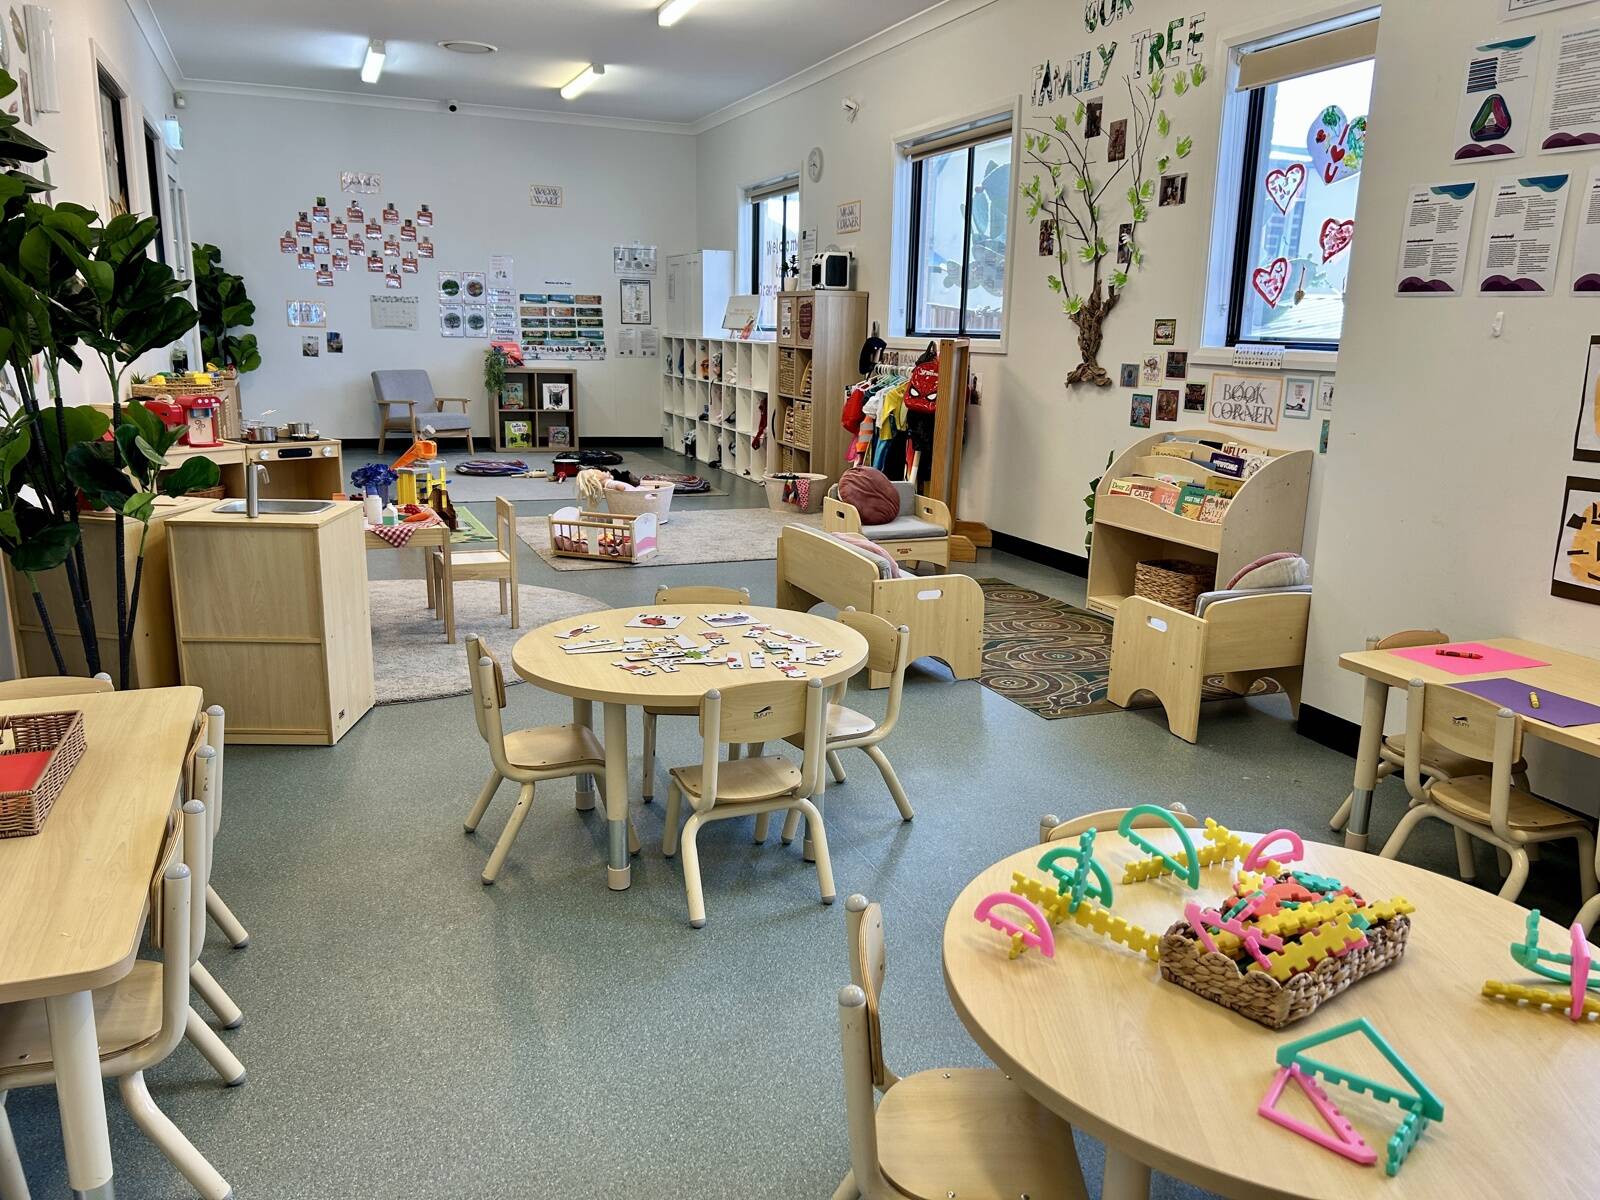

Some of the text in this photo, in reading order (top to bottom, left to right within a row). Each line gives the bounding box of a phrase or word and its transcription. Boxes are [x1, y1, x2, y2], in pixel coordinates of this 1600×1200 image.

[1032, 12, 1206, 106] FAMILY TREE
[1223, 381, 1267, 404] BOOK
[1212, 401, 1274, 424] CORNER
[1134, 489, 1149, 498] CATS
[1161, 494, 1176, 506] Tidy
